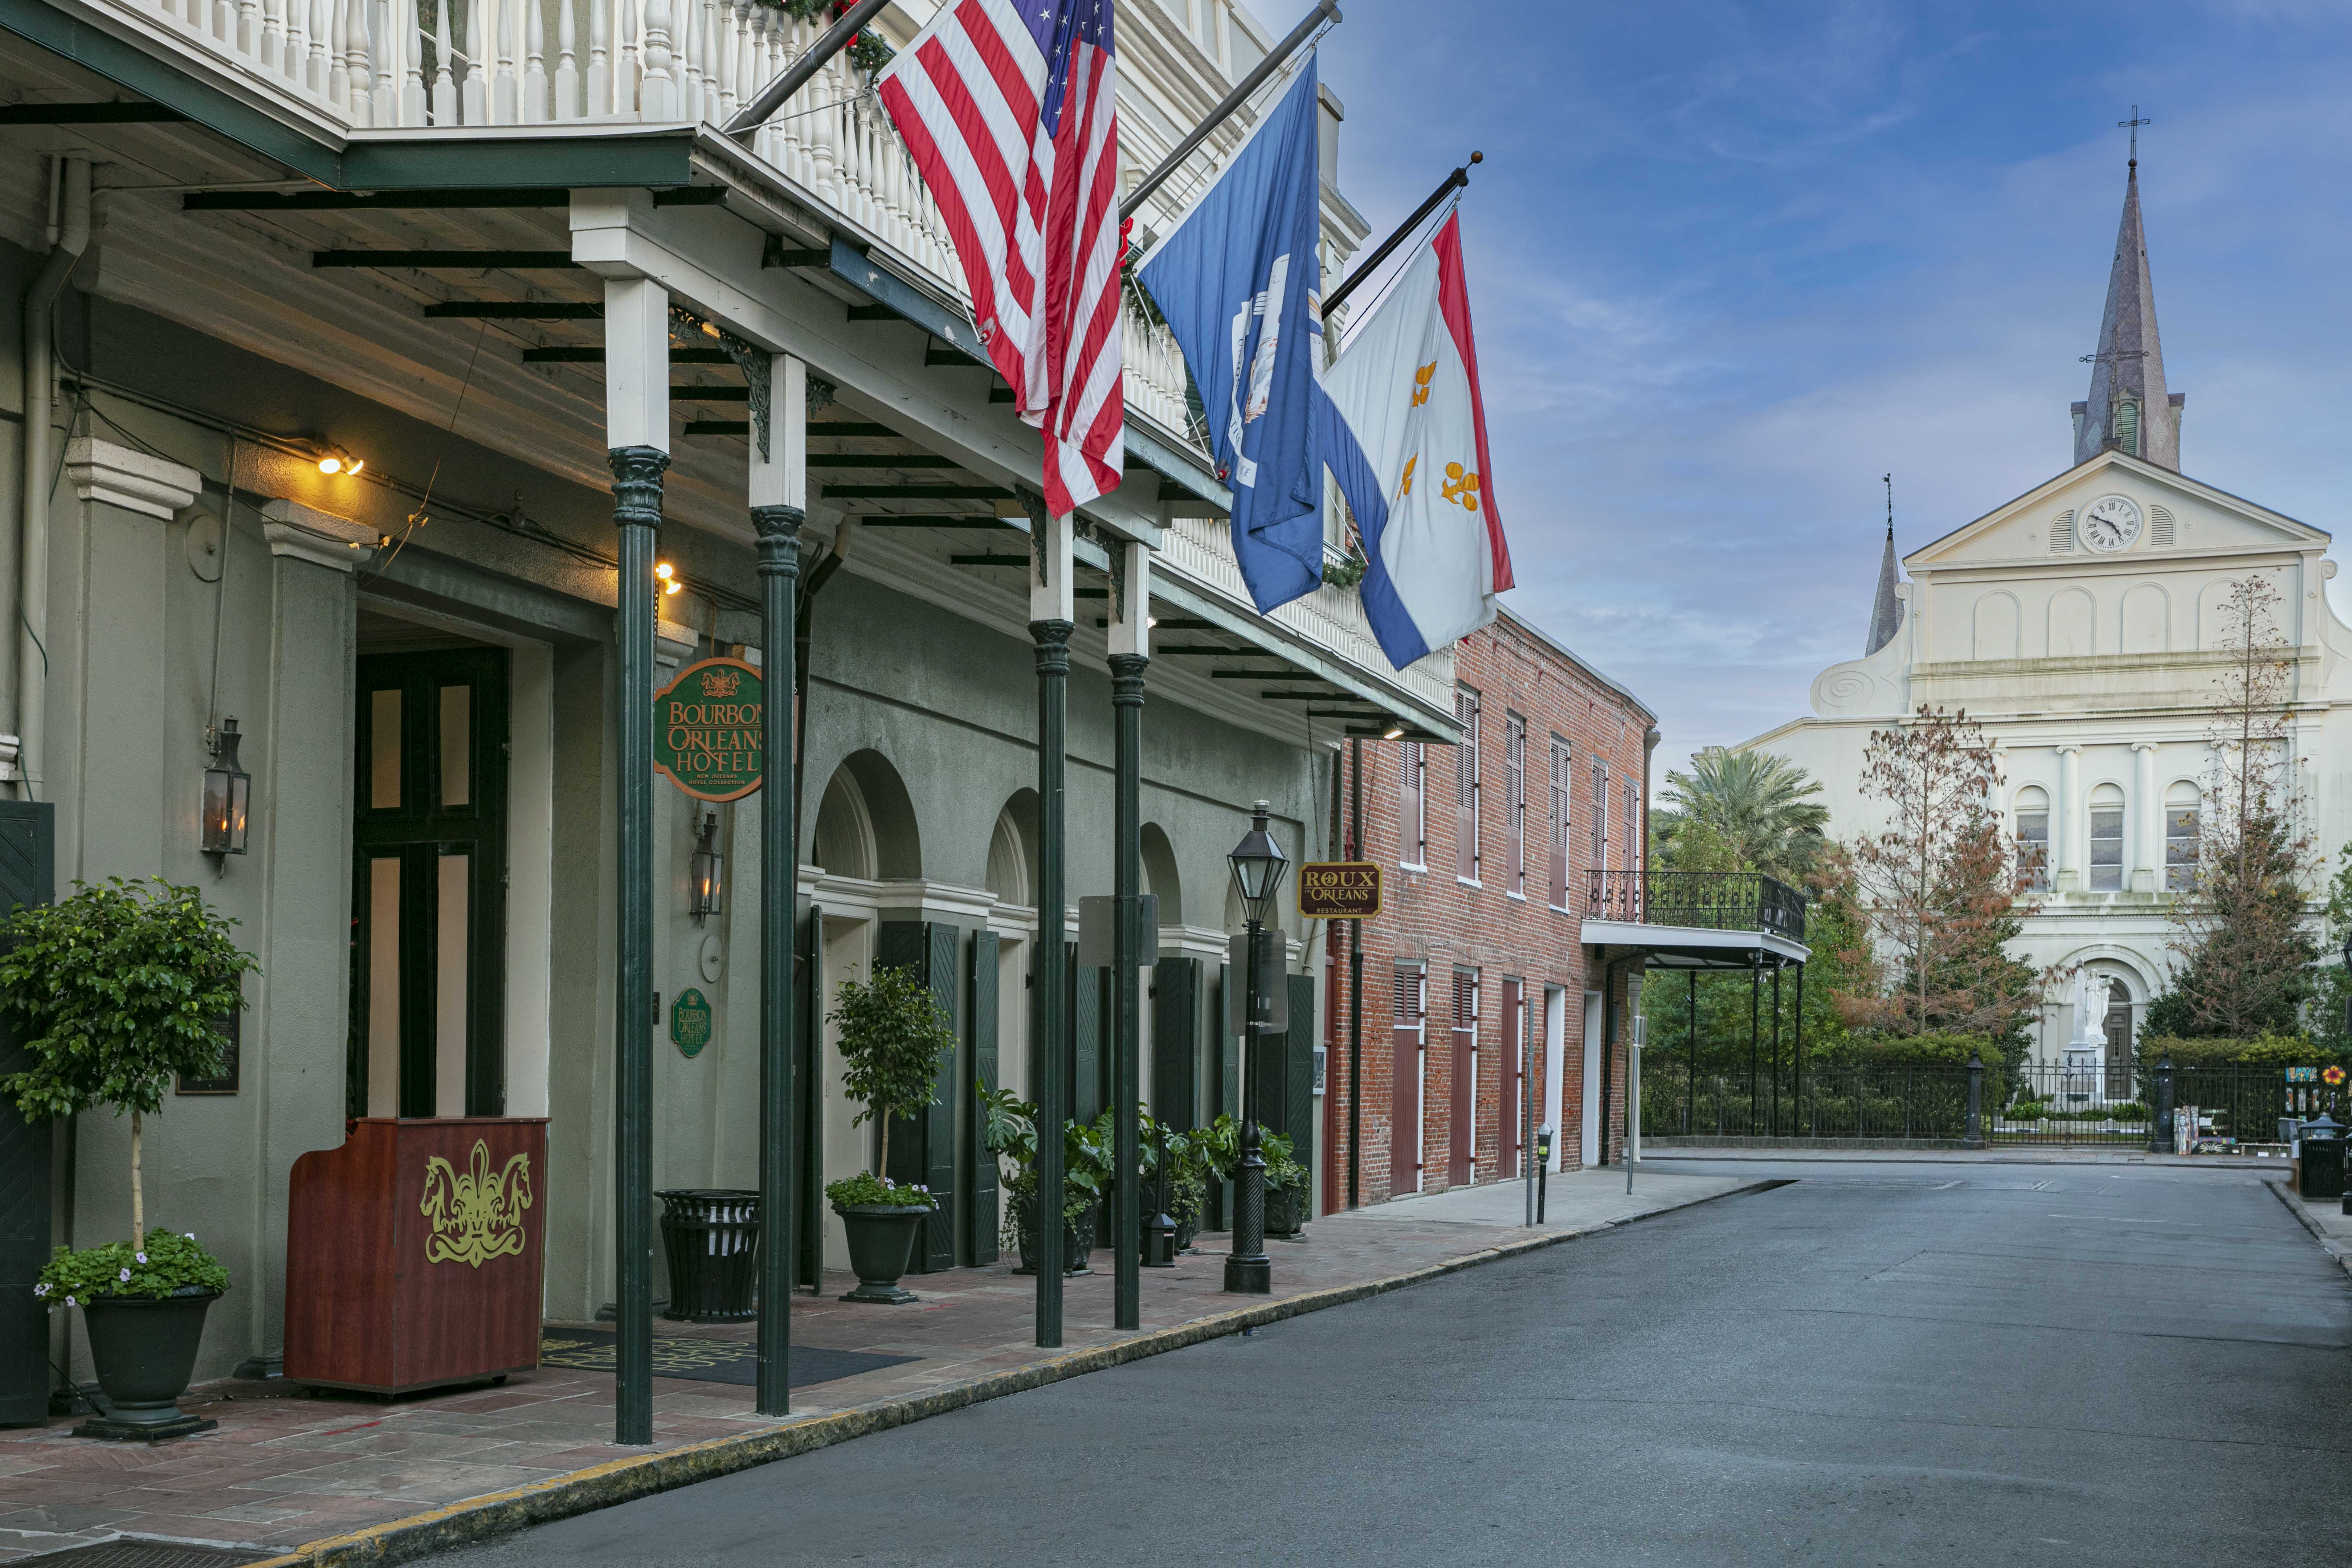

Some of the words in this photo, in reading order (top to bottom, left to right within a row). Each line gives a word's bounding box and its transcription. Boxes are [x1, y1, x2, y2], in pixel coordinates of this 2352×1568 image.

[676, 752, 758, 772] HOTEL
[1304, 872, 1375, 886] ROUX
[1311, 887, 1368, 900] ORLEANS
[678, 1008, 706, 1020] BOURBON
[678, 1021, 706, 1033] ORLEANS
[681, 1033, 703, 1044] HOTEL
